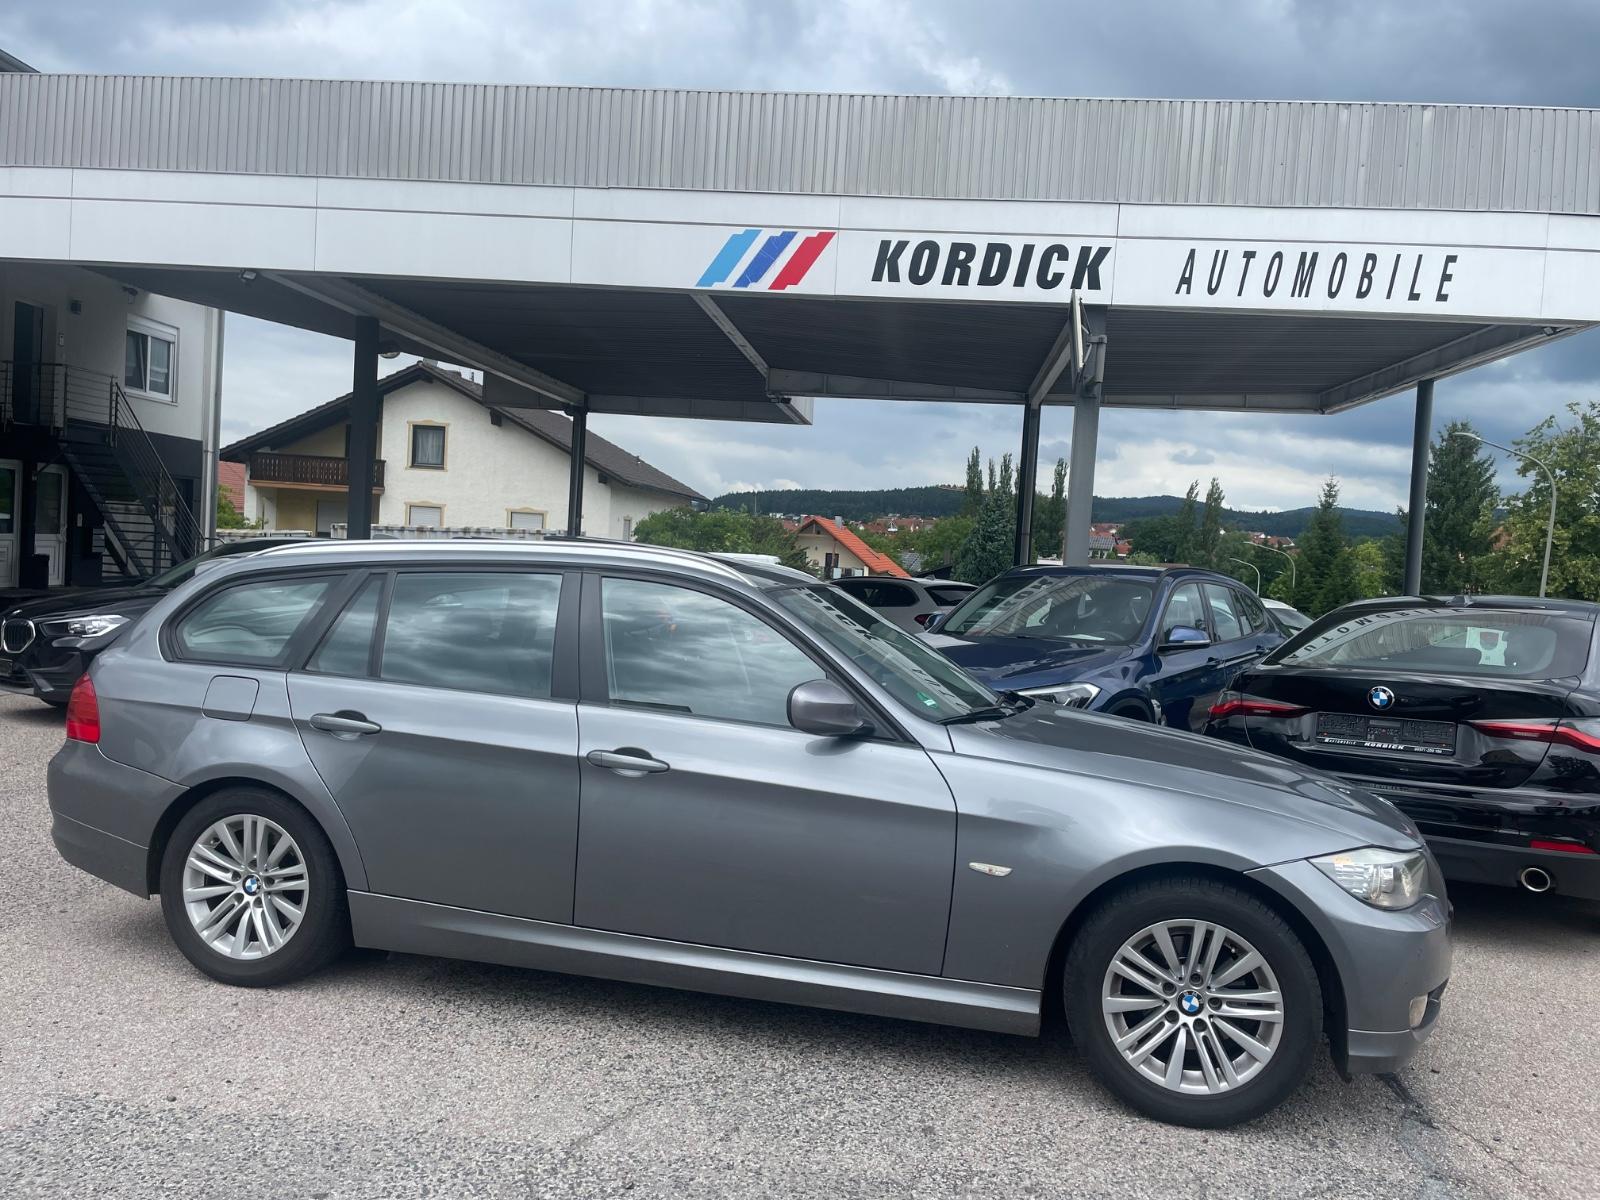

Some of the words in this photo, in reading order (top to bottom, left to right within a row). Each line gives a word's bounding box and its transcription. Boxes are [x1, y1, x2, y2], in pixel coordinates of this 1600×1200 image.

[871, 240, 1113, 290] KORDICK
[1175, 248, 1458, 302] AUTOMOBILE
[1364, 741, 1405, 750] KORDICK
